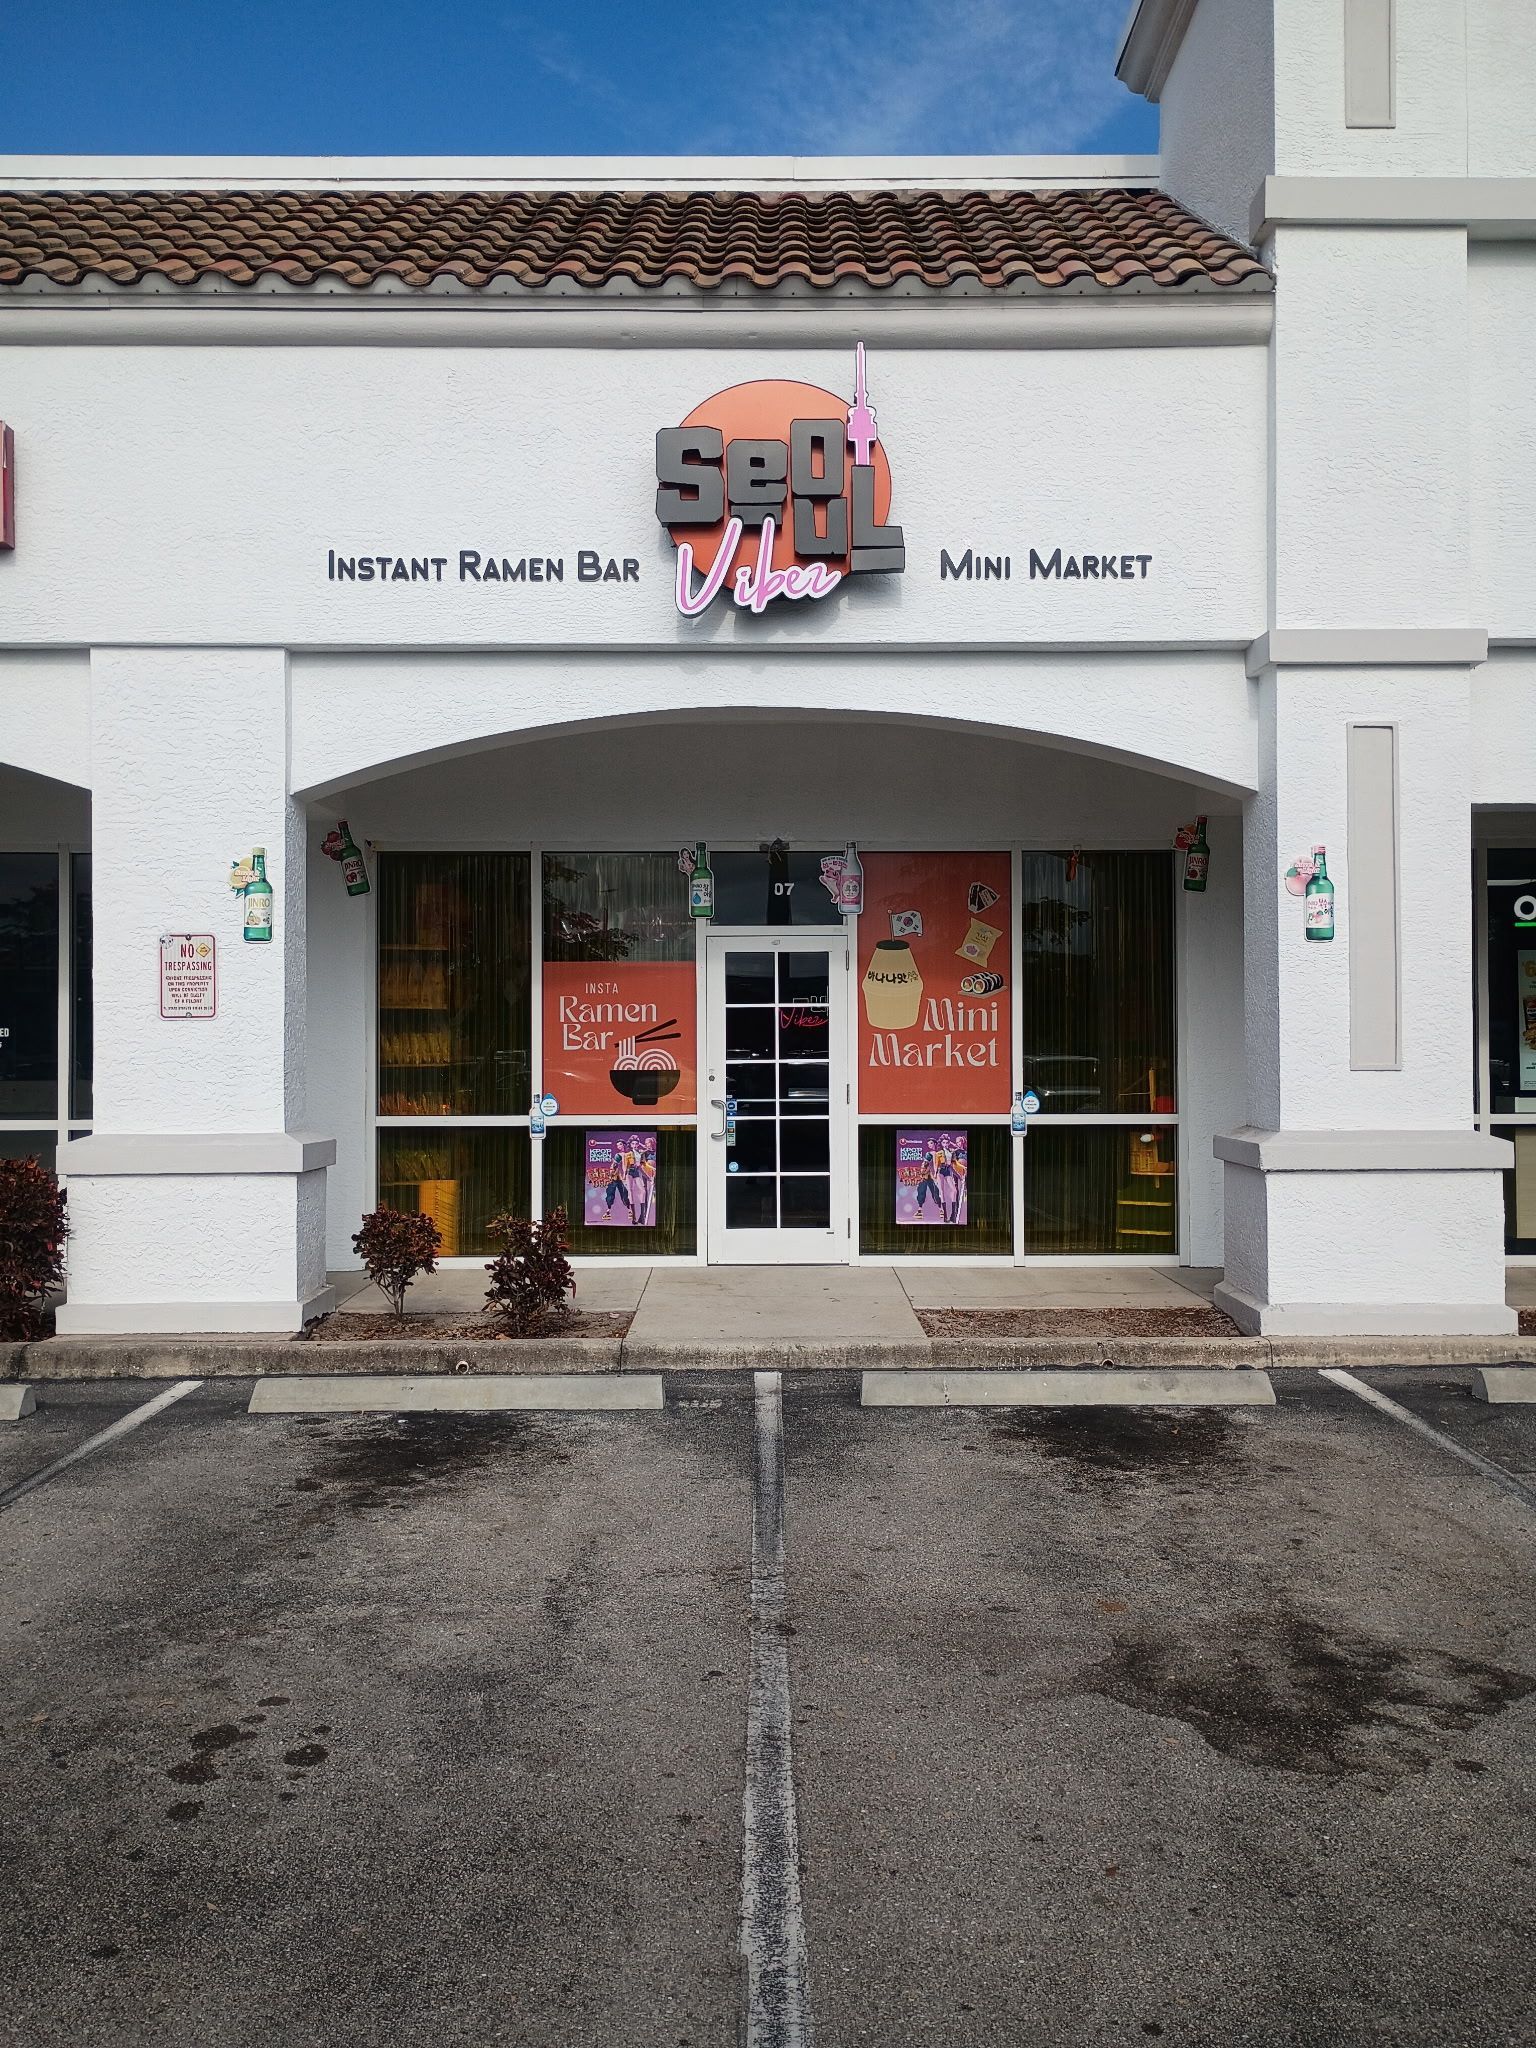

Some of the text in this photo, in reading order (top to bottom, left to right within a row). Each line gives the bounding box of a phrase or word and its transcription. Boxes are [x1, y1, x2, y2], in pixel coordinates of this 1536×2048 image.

[774, 882, 795, 896] 07
[248, 897, 270, 909] JINRO
[181, 944, 195, 958] NO
[165, 961, 212, 971] TRESPASSING
[585, 982, 619, 994] INSTA
[559, 995, 657, 1023] Ramen
[923, 998, 998, 1031] Mini
[563, 1023, 614, 1051] Bar
[869, 1033, 1000, 1067] Market
